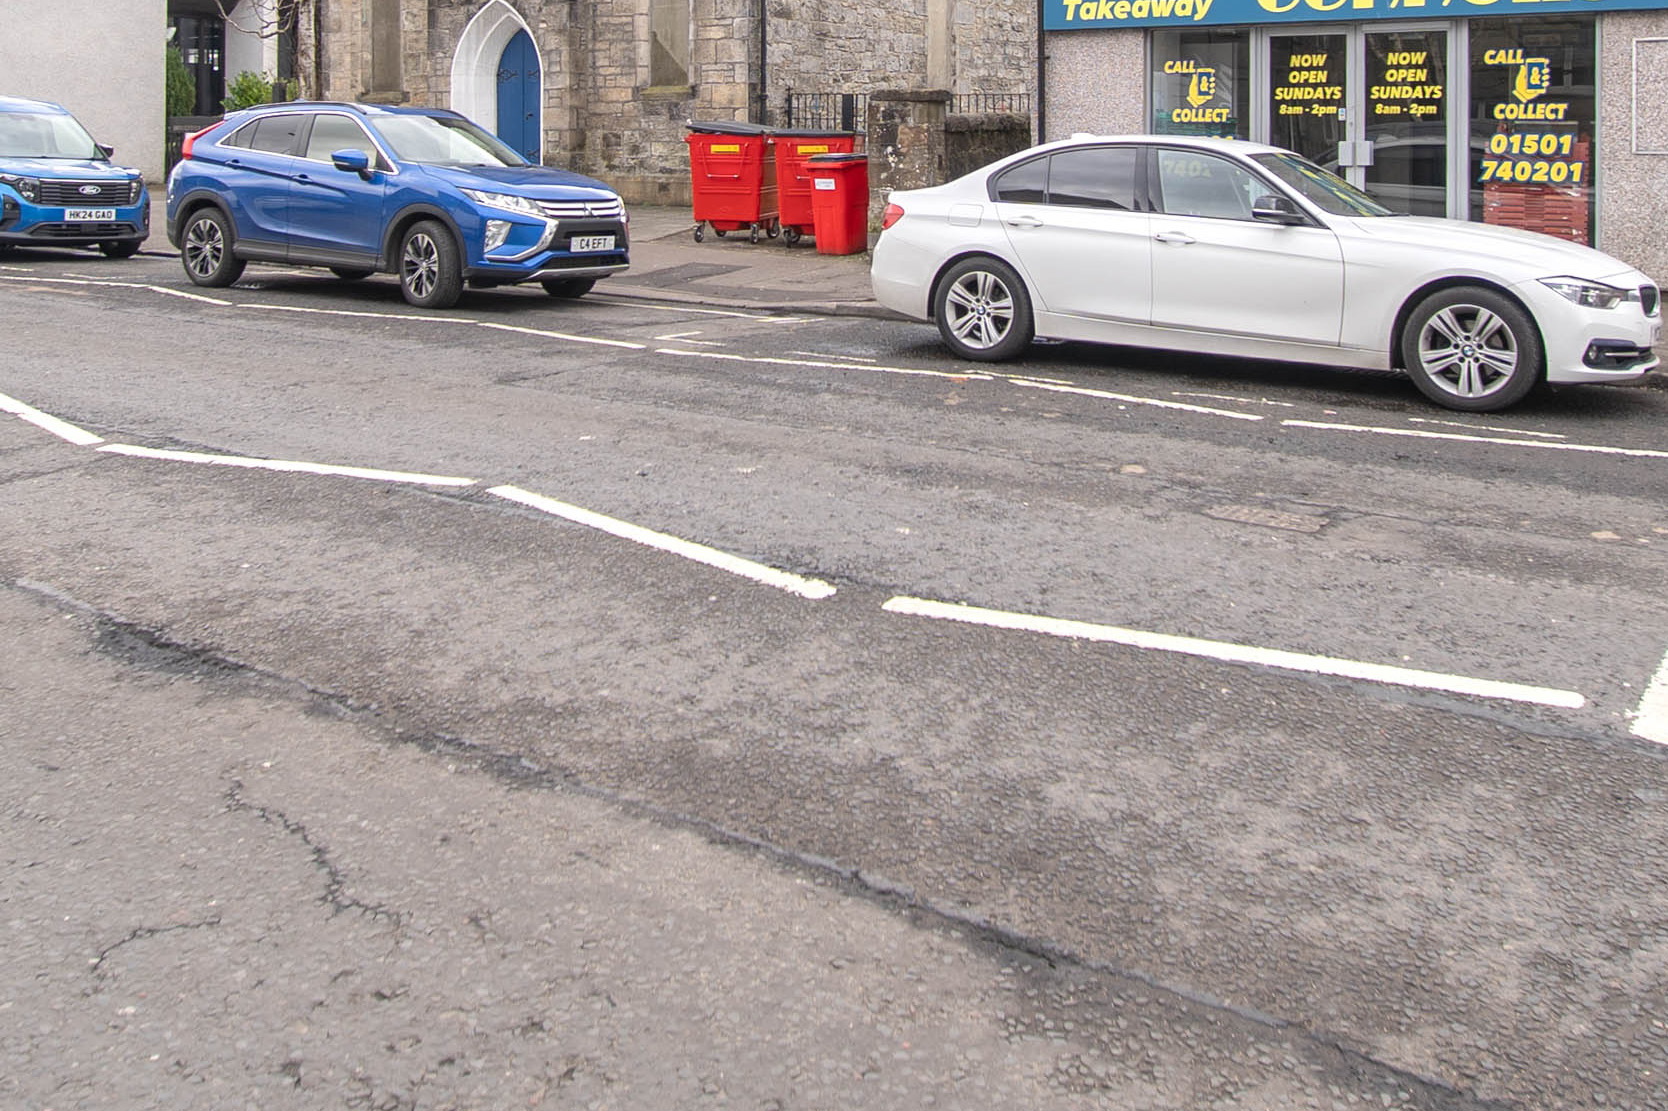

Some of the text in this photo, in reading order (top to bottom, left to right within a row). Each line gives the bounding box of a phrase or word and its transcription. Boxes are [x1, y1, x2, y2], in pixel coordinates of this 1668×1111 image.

[1289, 54, 1327, 68] NOW
[1387, 52, 1427, 66] NOW
[1484, 49, 1524, 65] CALL
[1164, 60, 1196, 74] CALL
[1288, 70, 1328, 84] OPEN
[1385, 68, 1428, 82] OPEN
[1529, 66, 1541, 85] &
[1274, 86, 1342, 100] SUNDAYS
[1370, 85, 1443, 99] SUNDAYS
[1172, 108, 1230, 123] COLLECT
[1279, 104, 1304, 115] 8am
[1311, 103, 1337, 117] 2pm
[1375, 103, 1401, 115] 8am
[1409, 103, 1437, 117] 2pm
[1493, 103, 1568, 120] COLLECT
[1490, 133, 1573, 155] 01501
[1480, 160, 1583, 182] 740201
[69, 210, 93, 219] HK24
[580, 238, 607, 249] C4 EFT
